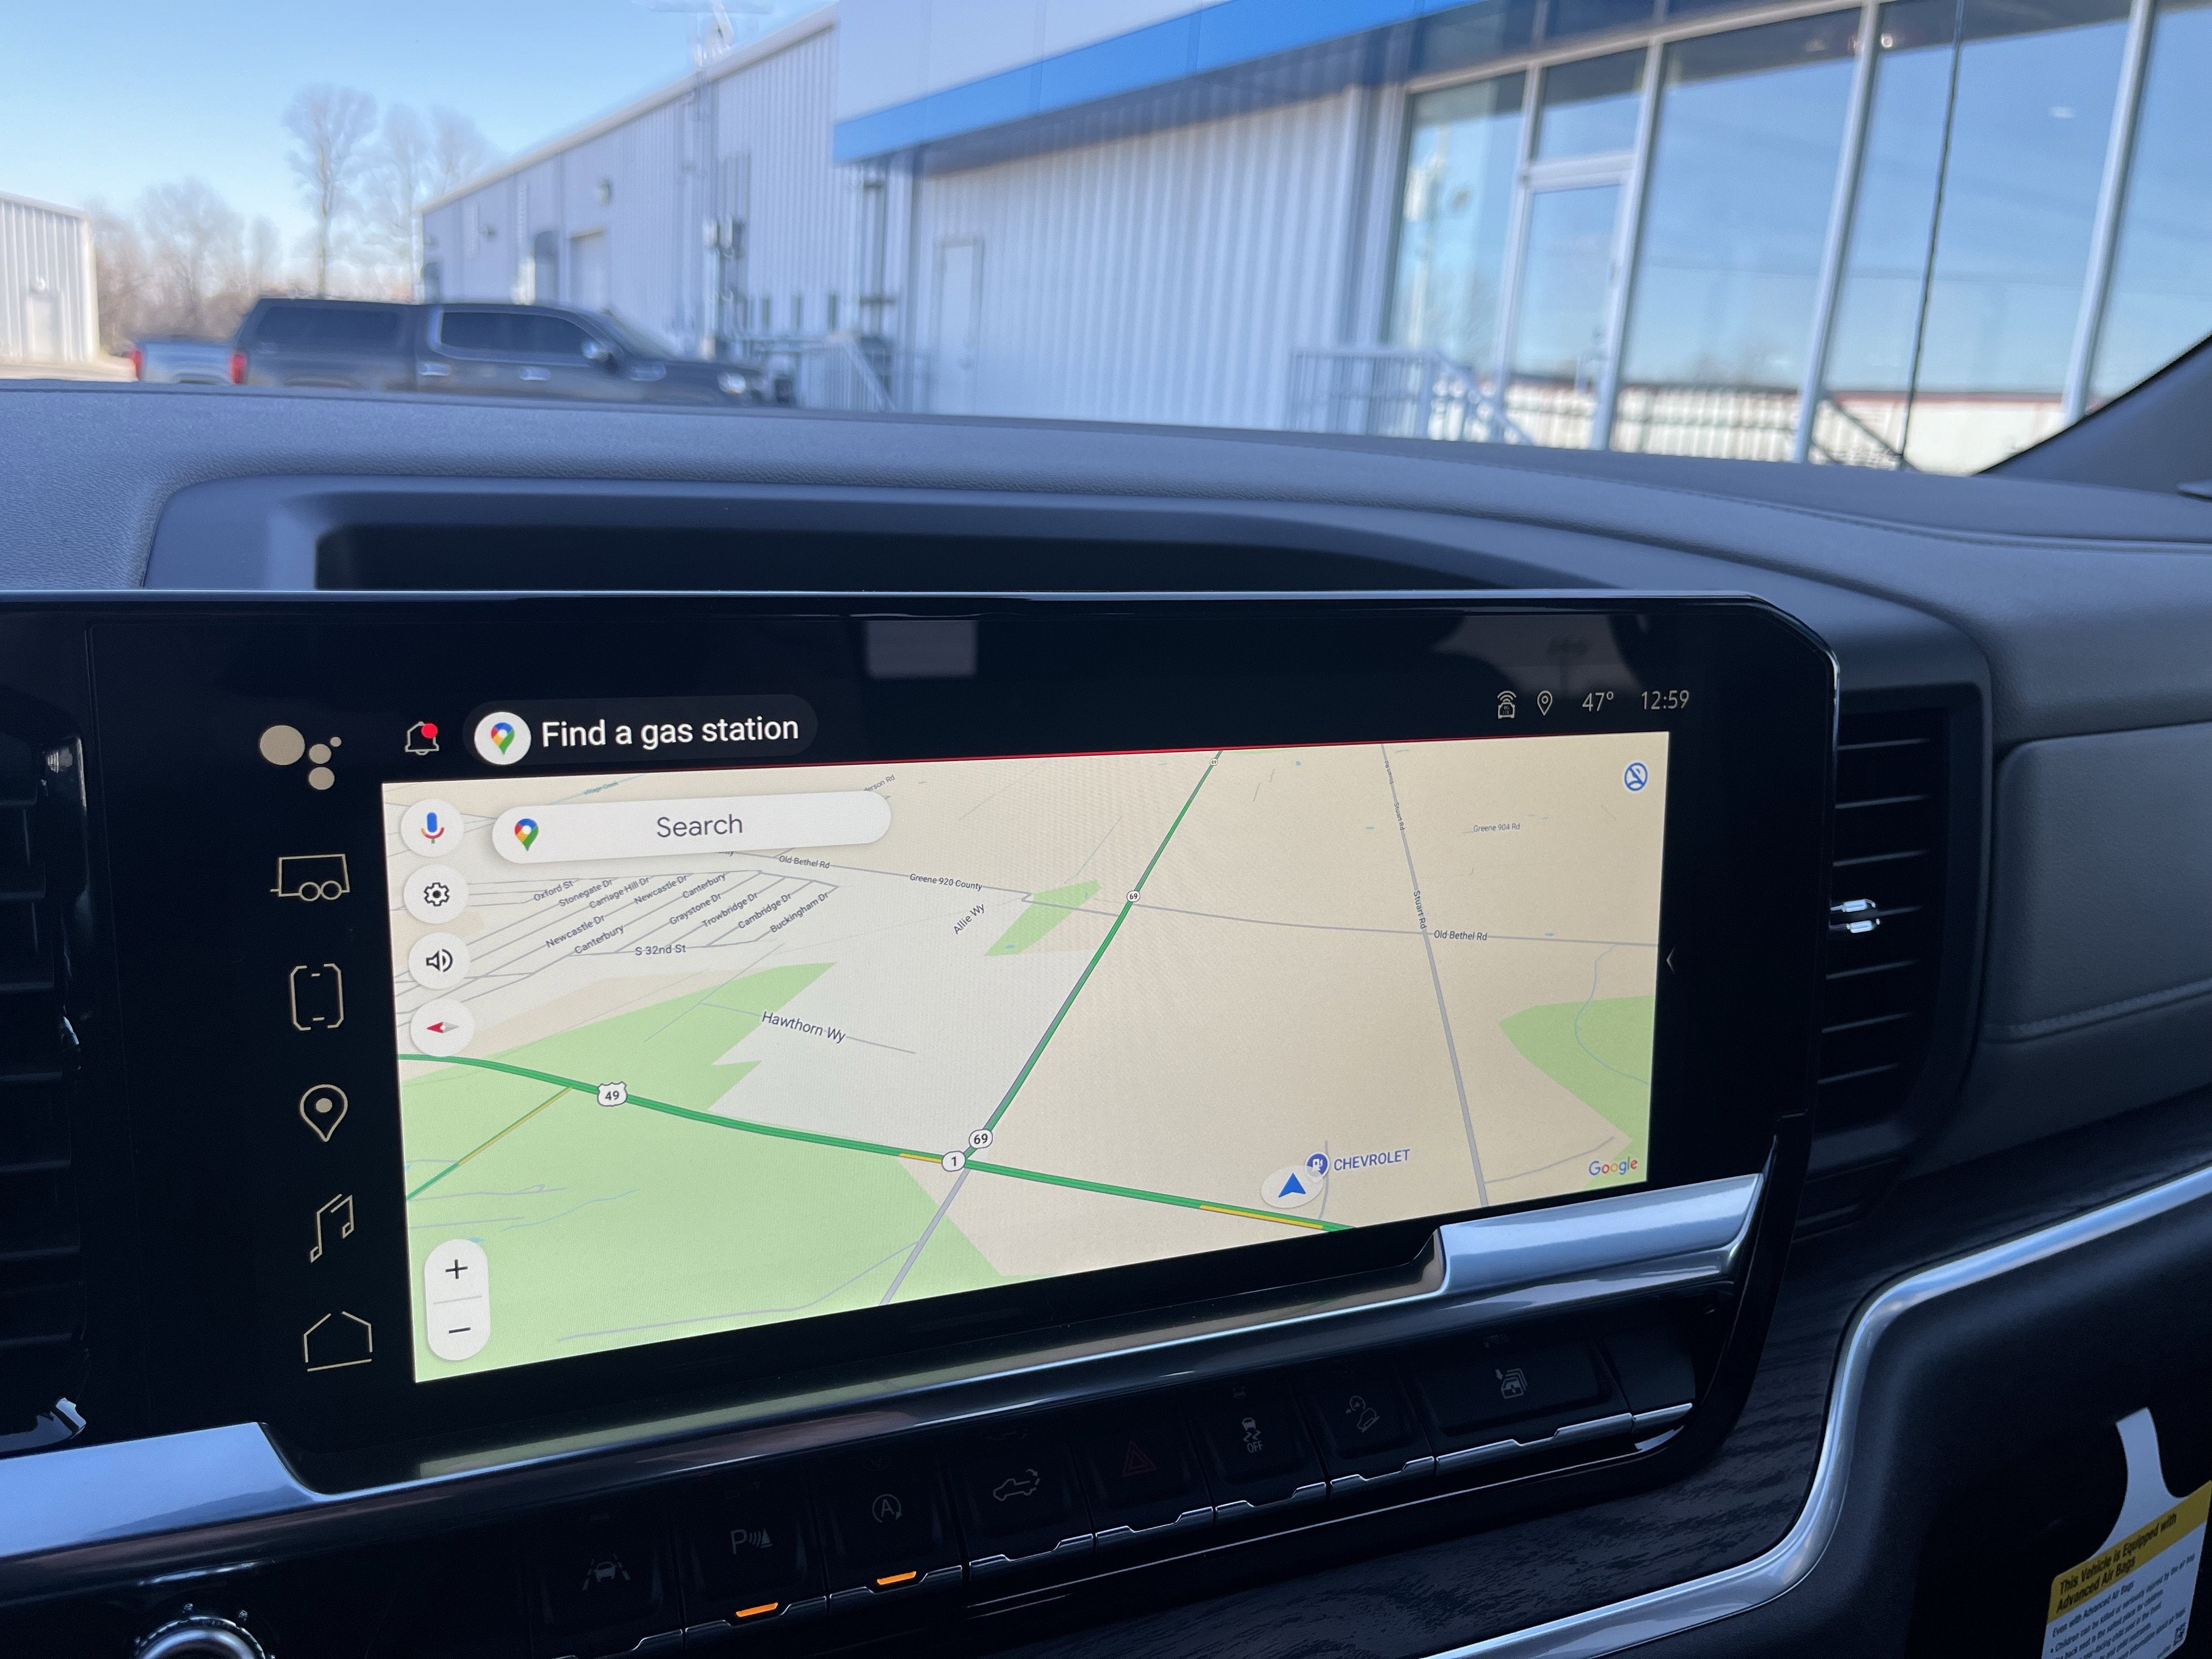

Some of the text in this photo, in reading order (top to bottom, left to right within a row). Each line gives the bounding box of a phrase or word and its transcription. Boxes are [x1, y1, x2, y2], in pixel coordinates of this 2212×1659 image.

[1641, 690, 1689, 710] 12:59
[542, 716, 799, 750] Find a gas station
[885, 774, 895, 783] Rd
[657, 814, 742, 837] Search
[1394, 802, 1405, 831] Stuart Rd
[794, 857, 818, 867] Bethel
[534, 881, 573, 900] Oxford St
[559, 879, 613, 906] Stonegate Dr
[589, 877, 650, 909] Carriage Hill Dr
[634, 874, 687, 904] Newcastle Dr
[683, 873, 726, 899] Canterbury
[910, 873, 983, 891] Greene 920 County
[670, 893, 721, 925] Graystone Dr
[702, 893, 758, 928] Trowbridge Dr
[738, 893, 792, 929] Cambridge Dr
[770, 892, 829, 933] Buckingham Dr
[953, 904, 985, 935] Allie Wy
[1414, 890, 1427, 929] Stuart Rd
[545, 915, 605, 948] Newcastle Dr
[574, 926, 624, 954] Canterbury
[1434, 930, 1487, 941] Old Bethel Rd
[635, 944, 686, 955] S 32nd St
[761, 1011, 847, 1044] Hawthorn Wy
[605, 1091, 619, 1101] 49
[974, 1133, 988, 1144] 69
[951, 1156, 957, 1166] 1
[1334, 1149, 1410, 1171] CHEVROLET
[1589, 1156, 1638, 1175] Google
[1247, 1440, 1263, 1453] OFF
[2061, 1514, 2176, 1594] This Vehicle is Equipped with
[2056, 1556, 2136, 1613] Advanced Air Bags
